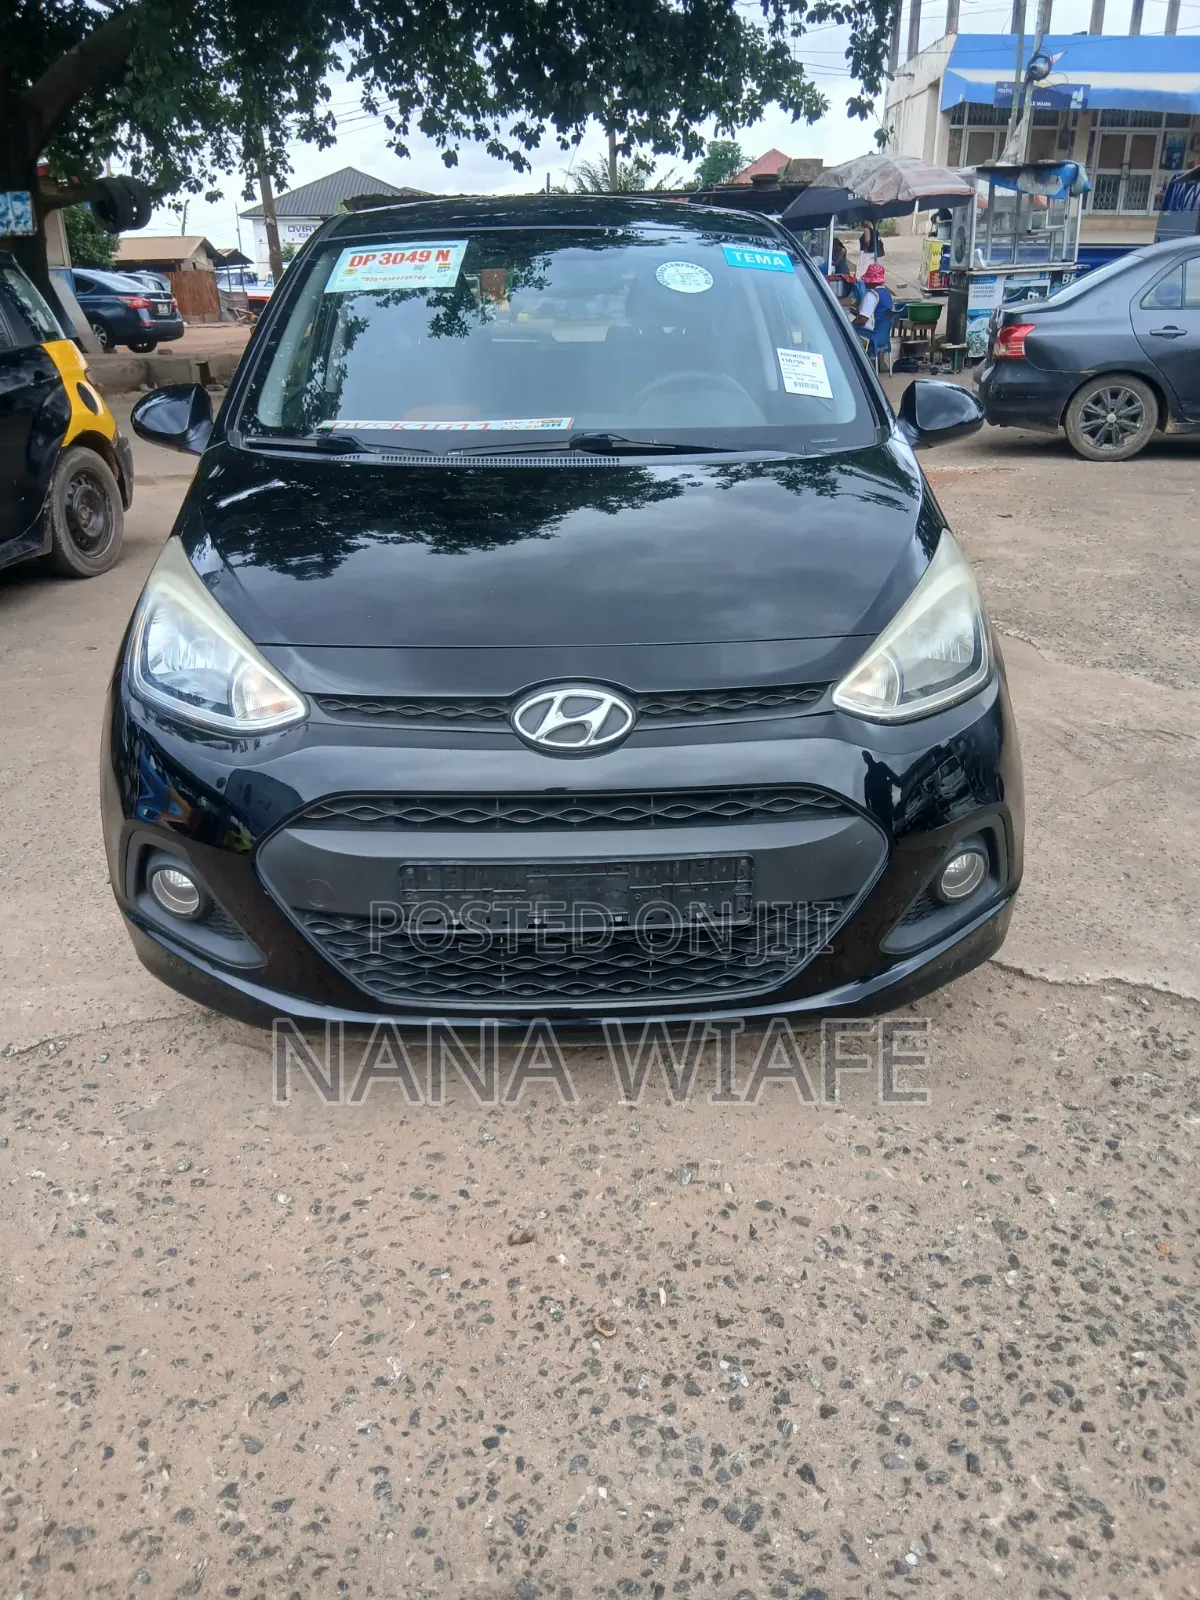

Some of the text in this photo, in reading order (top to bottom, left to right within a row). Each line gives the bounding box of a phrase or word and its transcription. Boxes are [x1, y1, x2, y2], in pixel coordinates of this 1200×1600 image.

[348, 249, 451, 267] DP 3049 N
[732, 251, 786, 267] TEMA
